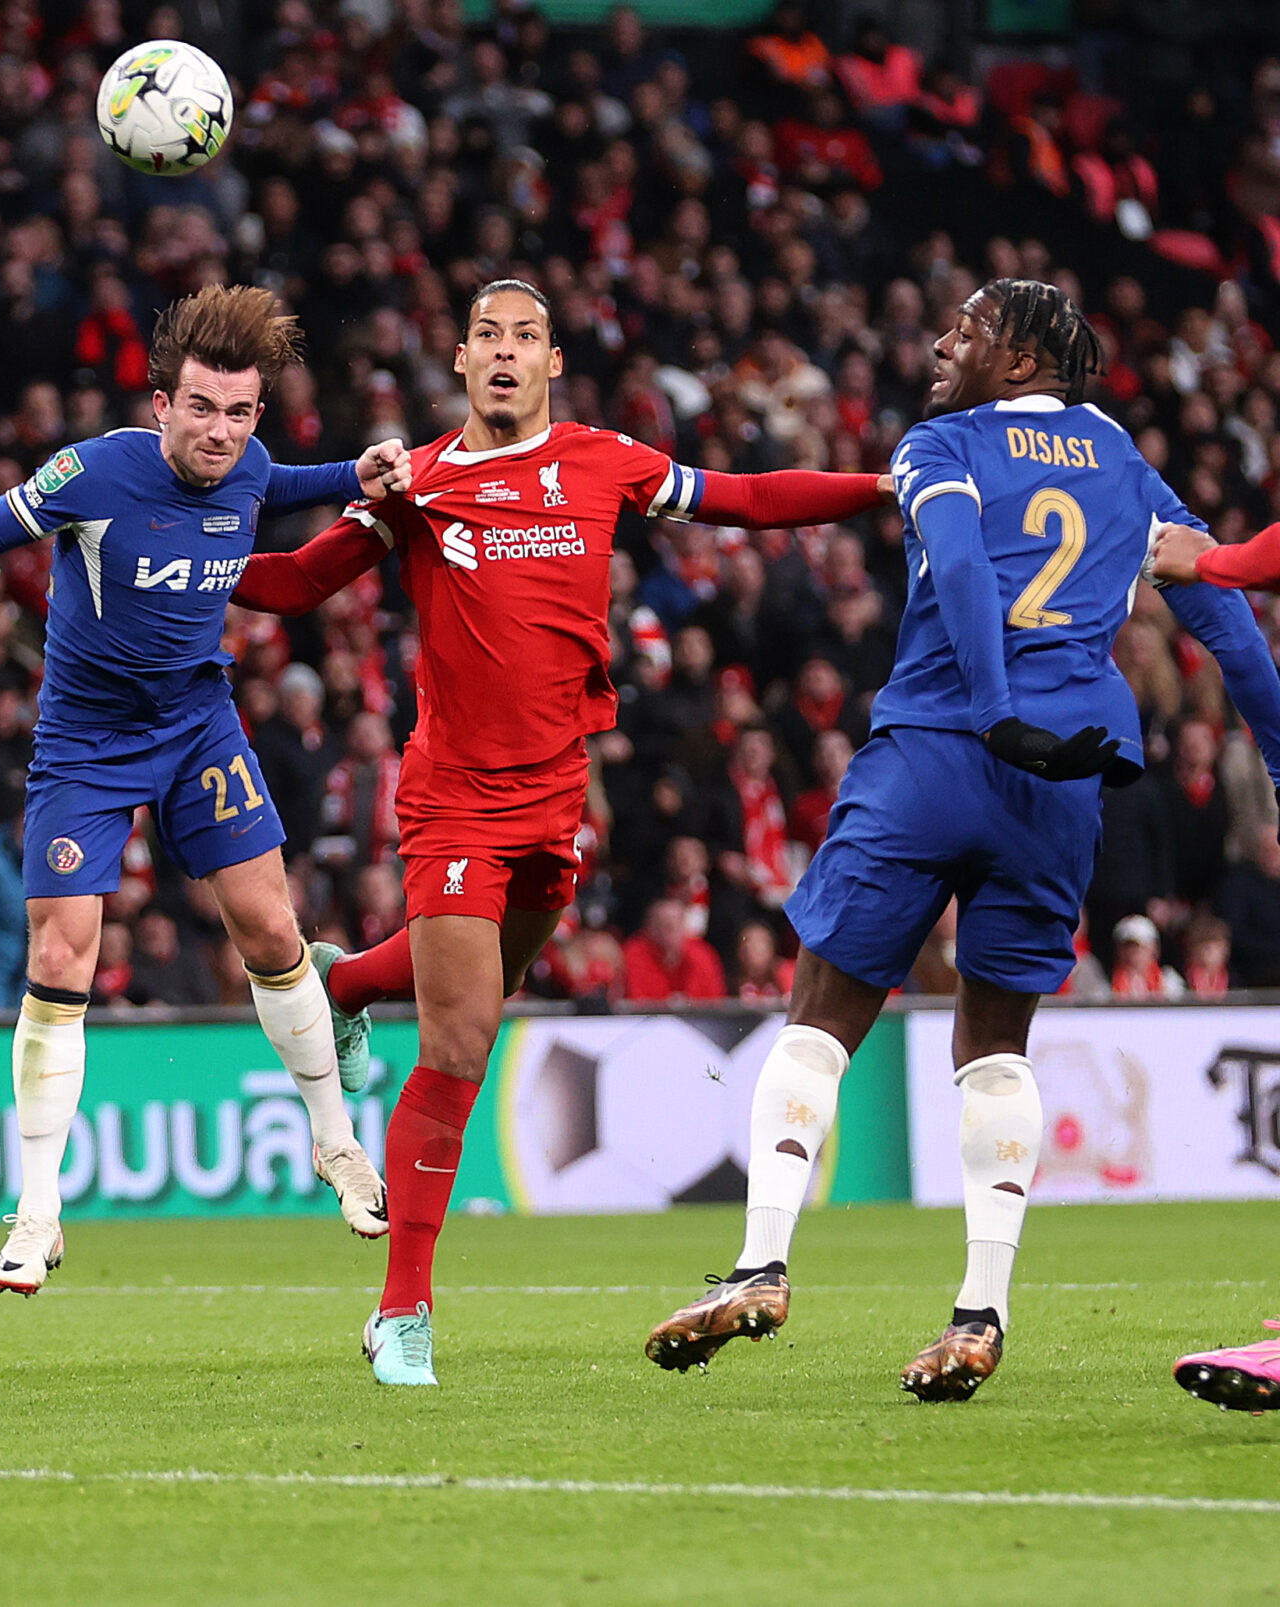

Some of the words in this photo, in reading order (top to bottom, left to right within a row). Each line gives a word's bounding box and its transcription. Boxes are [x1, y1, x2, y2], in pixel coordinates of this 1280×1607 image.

[1006, 427, 1099, 469] DISASI
[482, 521, 577, 546] standard
[484, 538, 586, 561] chartered
[1007, 486, 1087, 629] 2
[200, 754, 265, 822] 21
